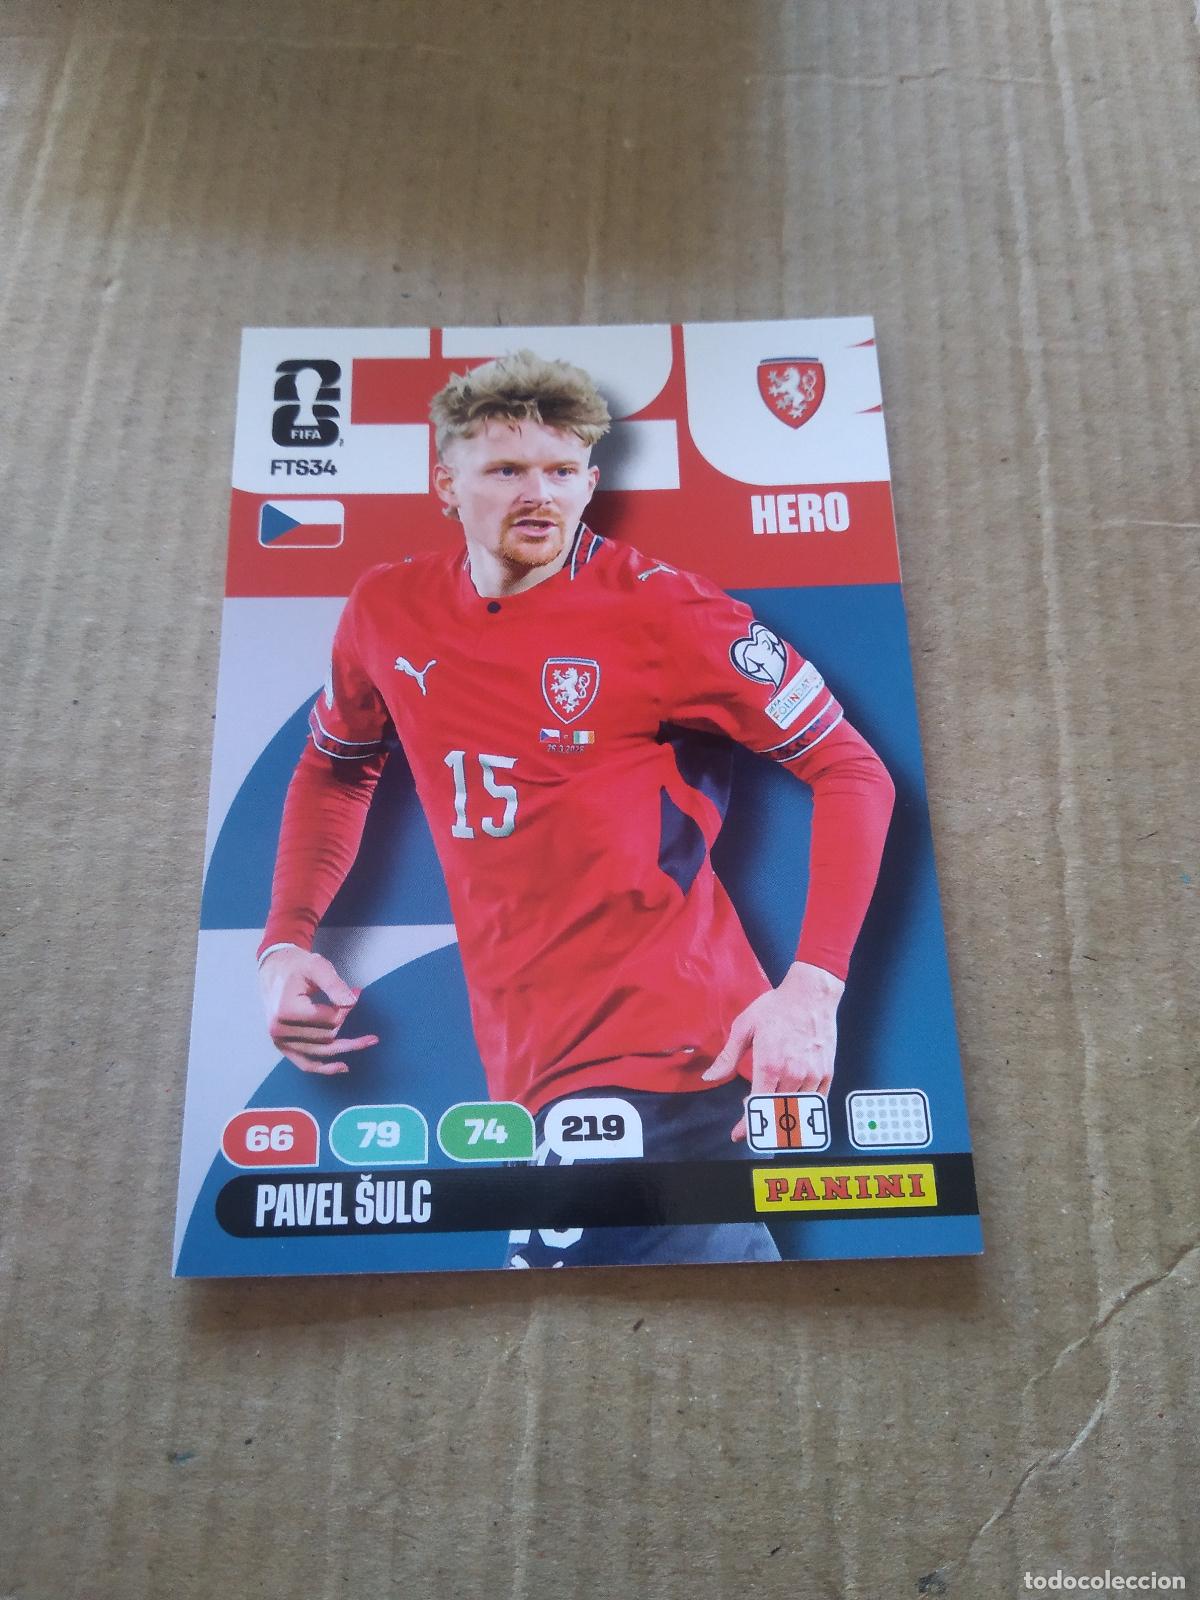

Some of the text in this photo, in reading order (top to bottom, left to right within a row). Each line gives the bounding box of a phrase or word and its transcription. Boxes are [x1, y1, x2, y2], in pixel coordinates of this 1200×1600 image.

[290, 428, 322, 440] FIFA
[270, 459, 338, 476] FTS34
[750, 491, 850, 534] HERO
[444, 750, 518, 838] 15
[246, 1125, 294, 1151] 66
[357, 1121, 401, 1148] 79
[464, 1118, 508, 1145] 74
[562, 1115, 626, 1141] 219
[255, 1174, 432, 1228] PAVEL ŠULC
[764, 1174, 925, 1202] PANINI
